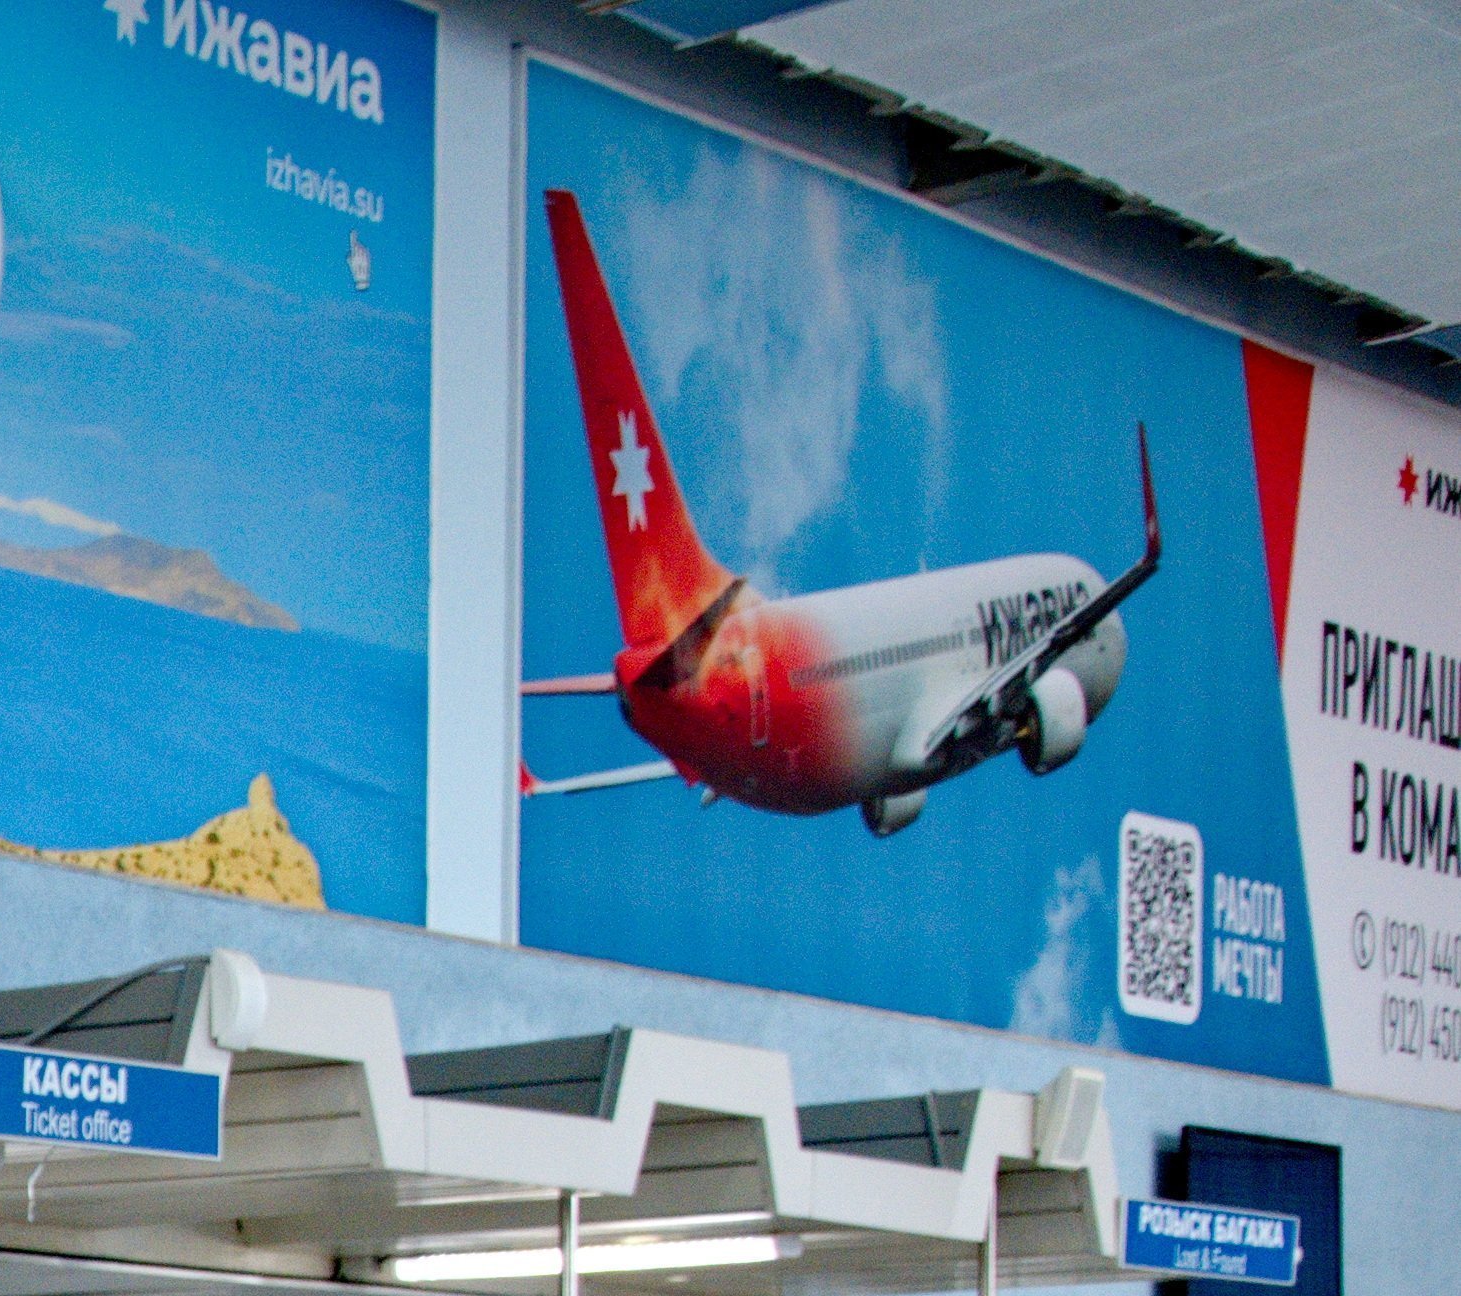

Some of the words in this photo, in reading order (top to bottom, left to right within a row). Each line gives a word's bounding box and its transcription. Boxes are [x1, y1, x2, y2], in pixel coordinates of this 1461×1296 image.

[163, 0, 385, 125] ижавиа
[265, 146, 385, 223] izhavia.su
[1352, 760, 1369, 854] В
[1213, 871, 1286, 943] РАБОТА
[1212, 936, 1285, 1006] МЕЧТЫ
[22, 1055, 129, 1105] КАССЫ
[20, 1100, 79, 1139] Ticket
[81, 1108, 134, 1145] office
